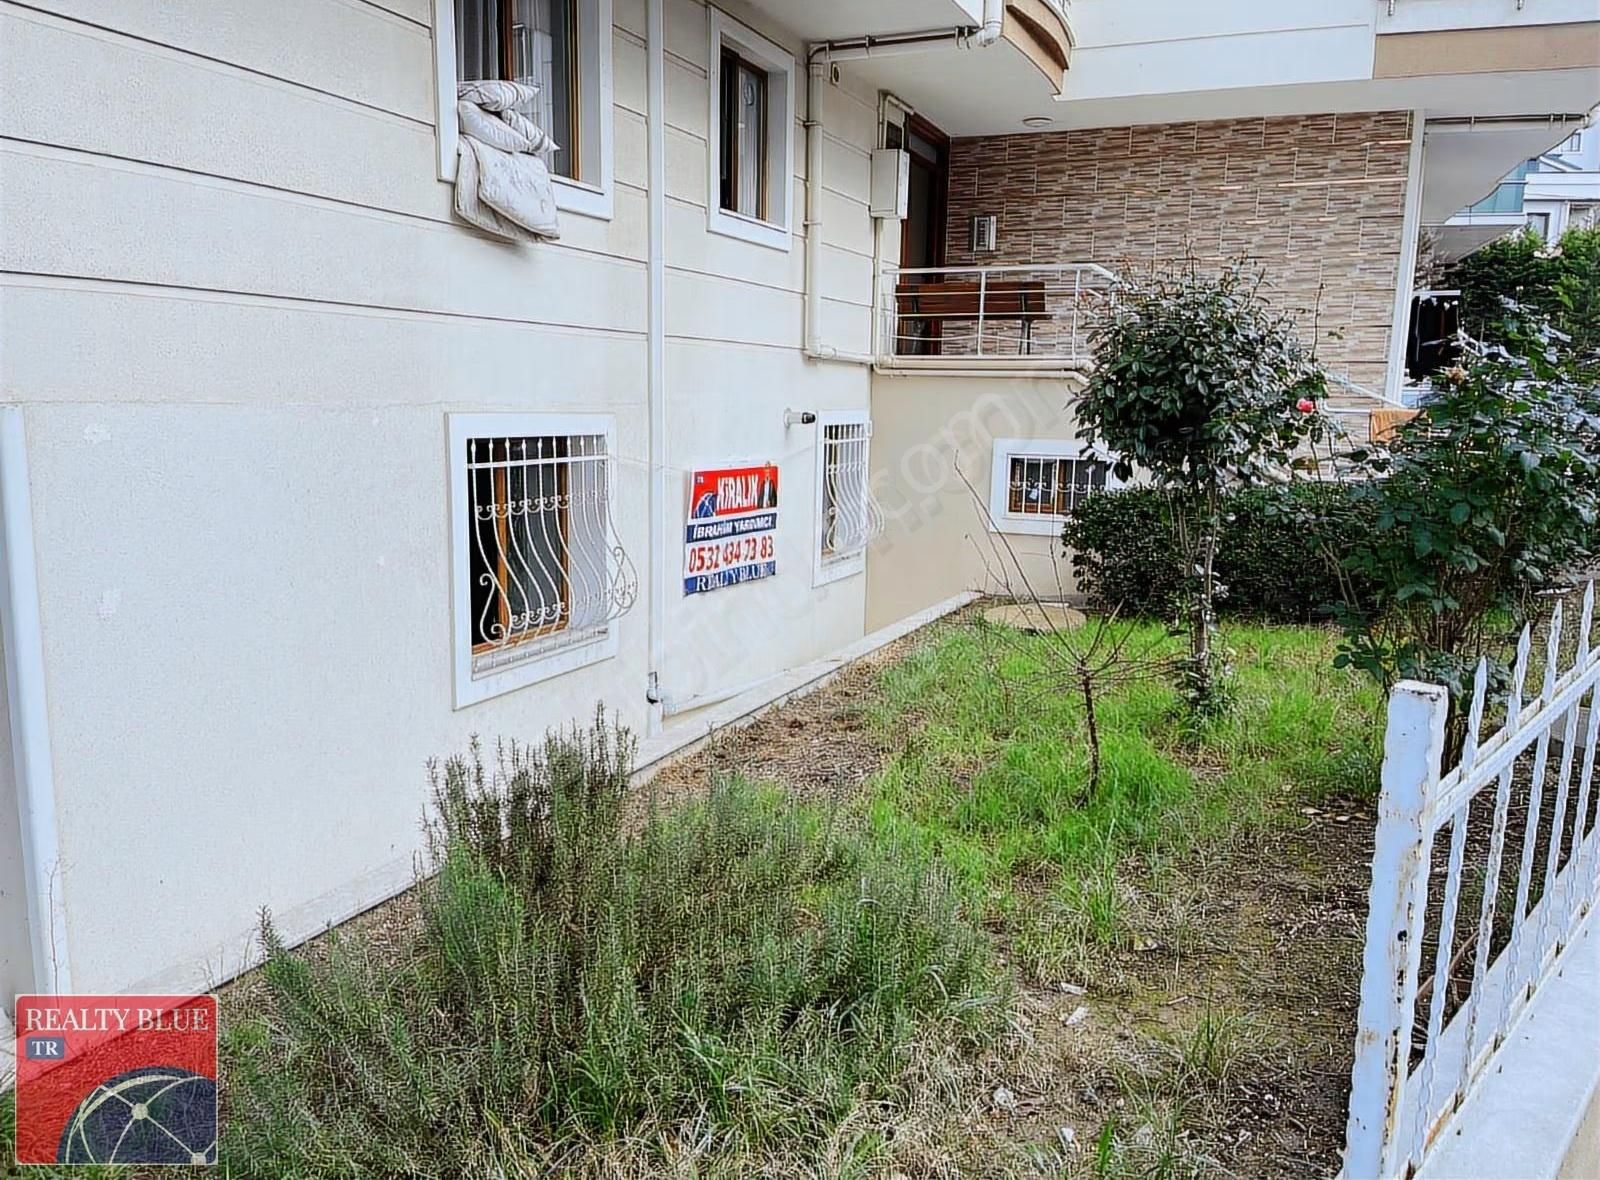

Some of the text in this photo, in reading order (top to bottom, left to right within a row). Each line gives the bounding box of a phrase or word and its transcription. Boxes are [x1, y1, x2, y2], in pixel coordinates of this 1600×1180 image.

[688, 544, 720, 573] 0532
[744, 537, 758, 561] 73
[760, 535, 774, 559] 83
